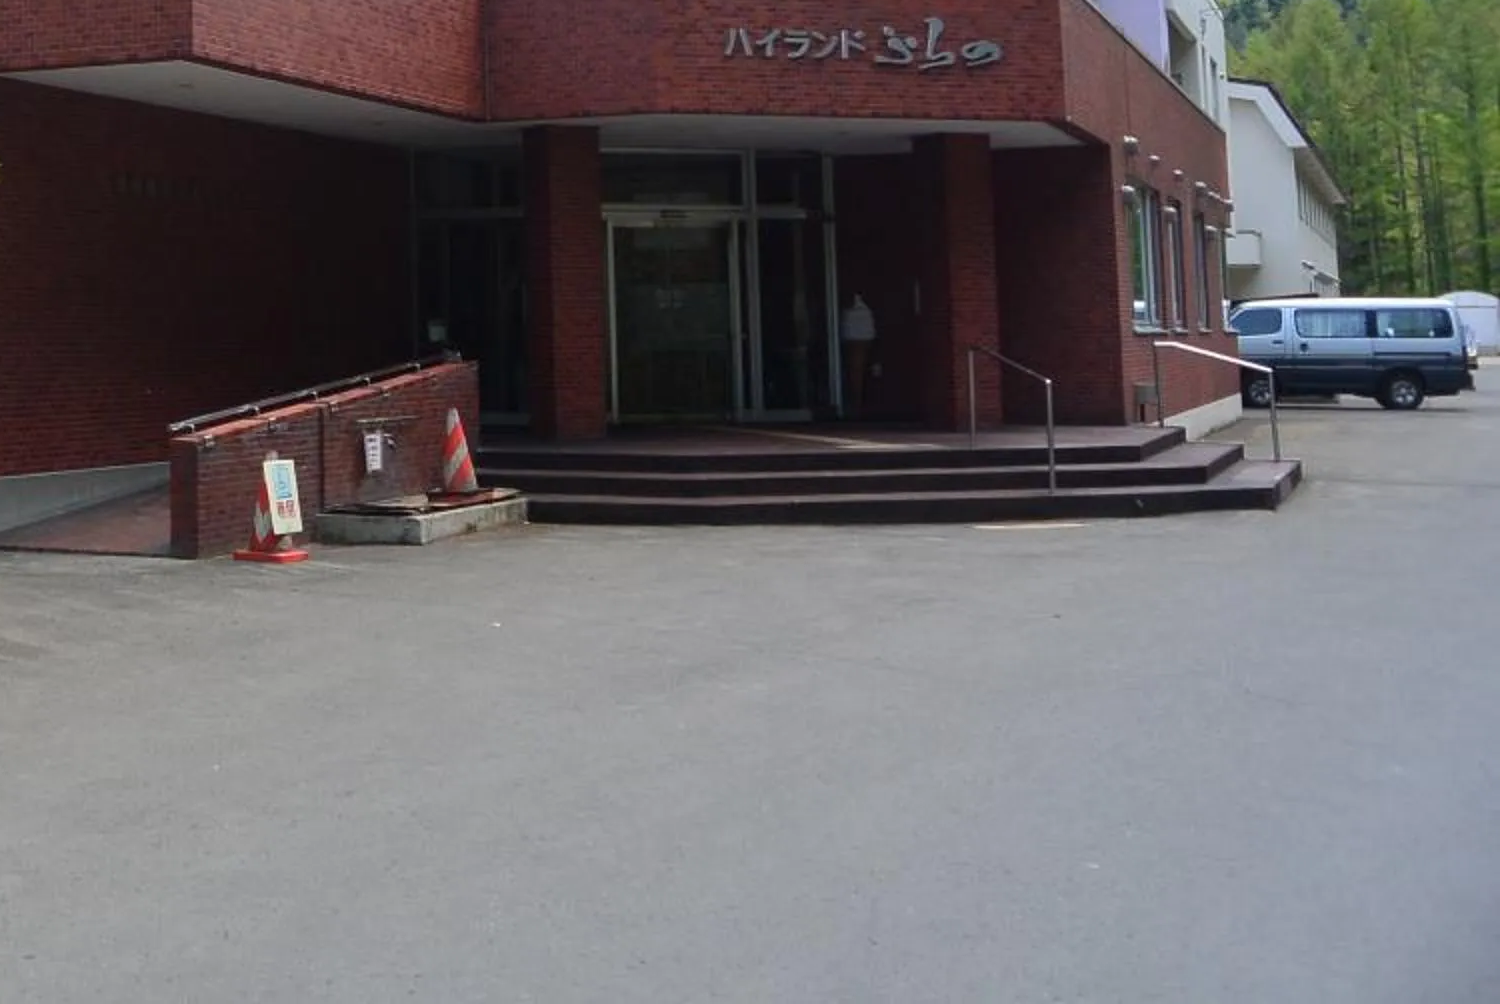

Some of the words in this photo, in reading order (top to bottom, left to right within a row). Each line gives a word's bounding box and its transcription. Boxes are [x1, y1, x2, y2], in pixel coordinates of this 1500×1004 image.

[724, 27, 866, 60] ハイランド
